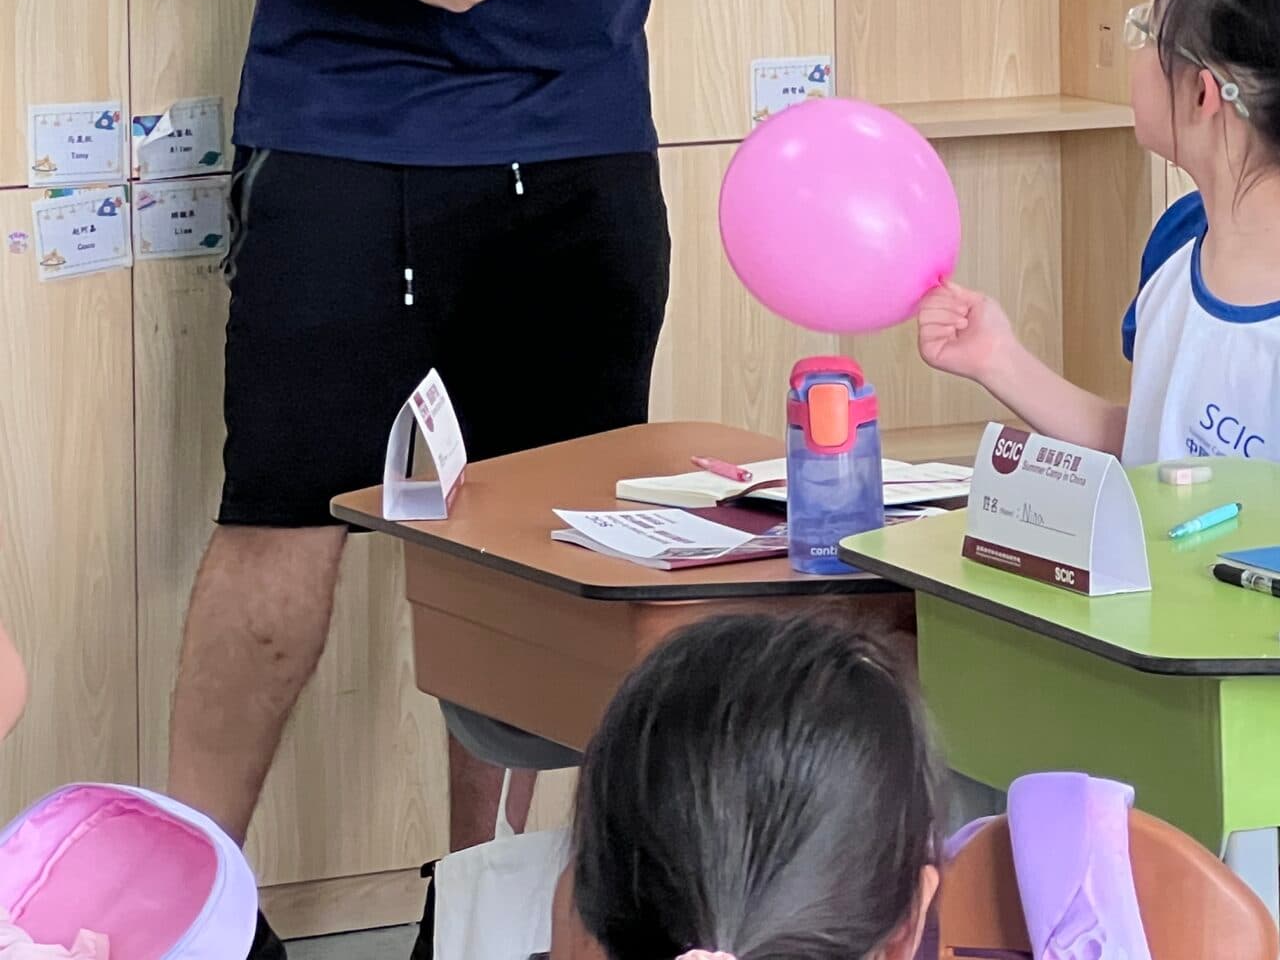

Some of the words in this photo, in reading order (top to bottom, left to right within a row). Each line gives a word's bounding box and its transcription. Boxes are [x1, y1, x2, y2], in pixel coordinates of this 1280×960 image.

[1199, 403, 1265, 458] SCIC
[995, 438, 1023, 461] SCIC
[1055, 566, 1075, 585] SCIC
